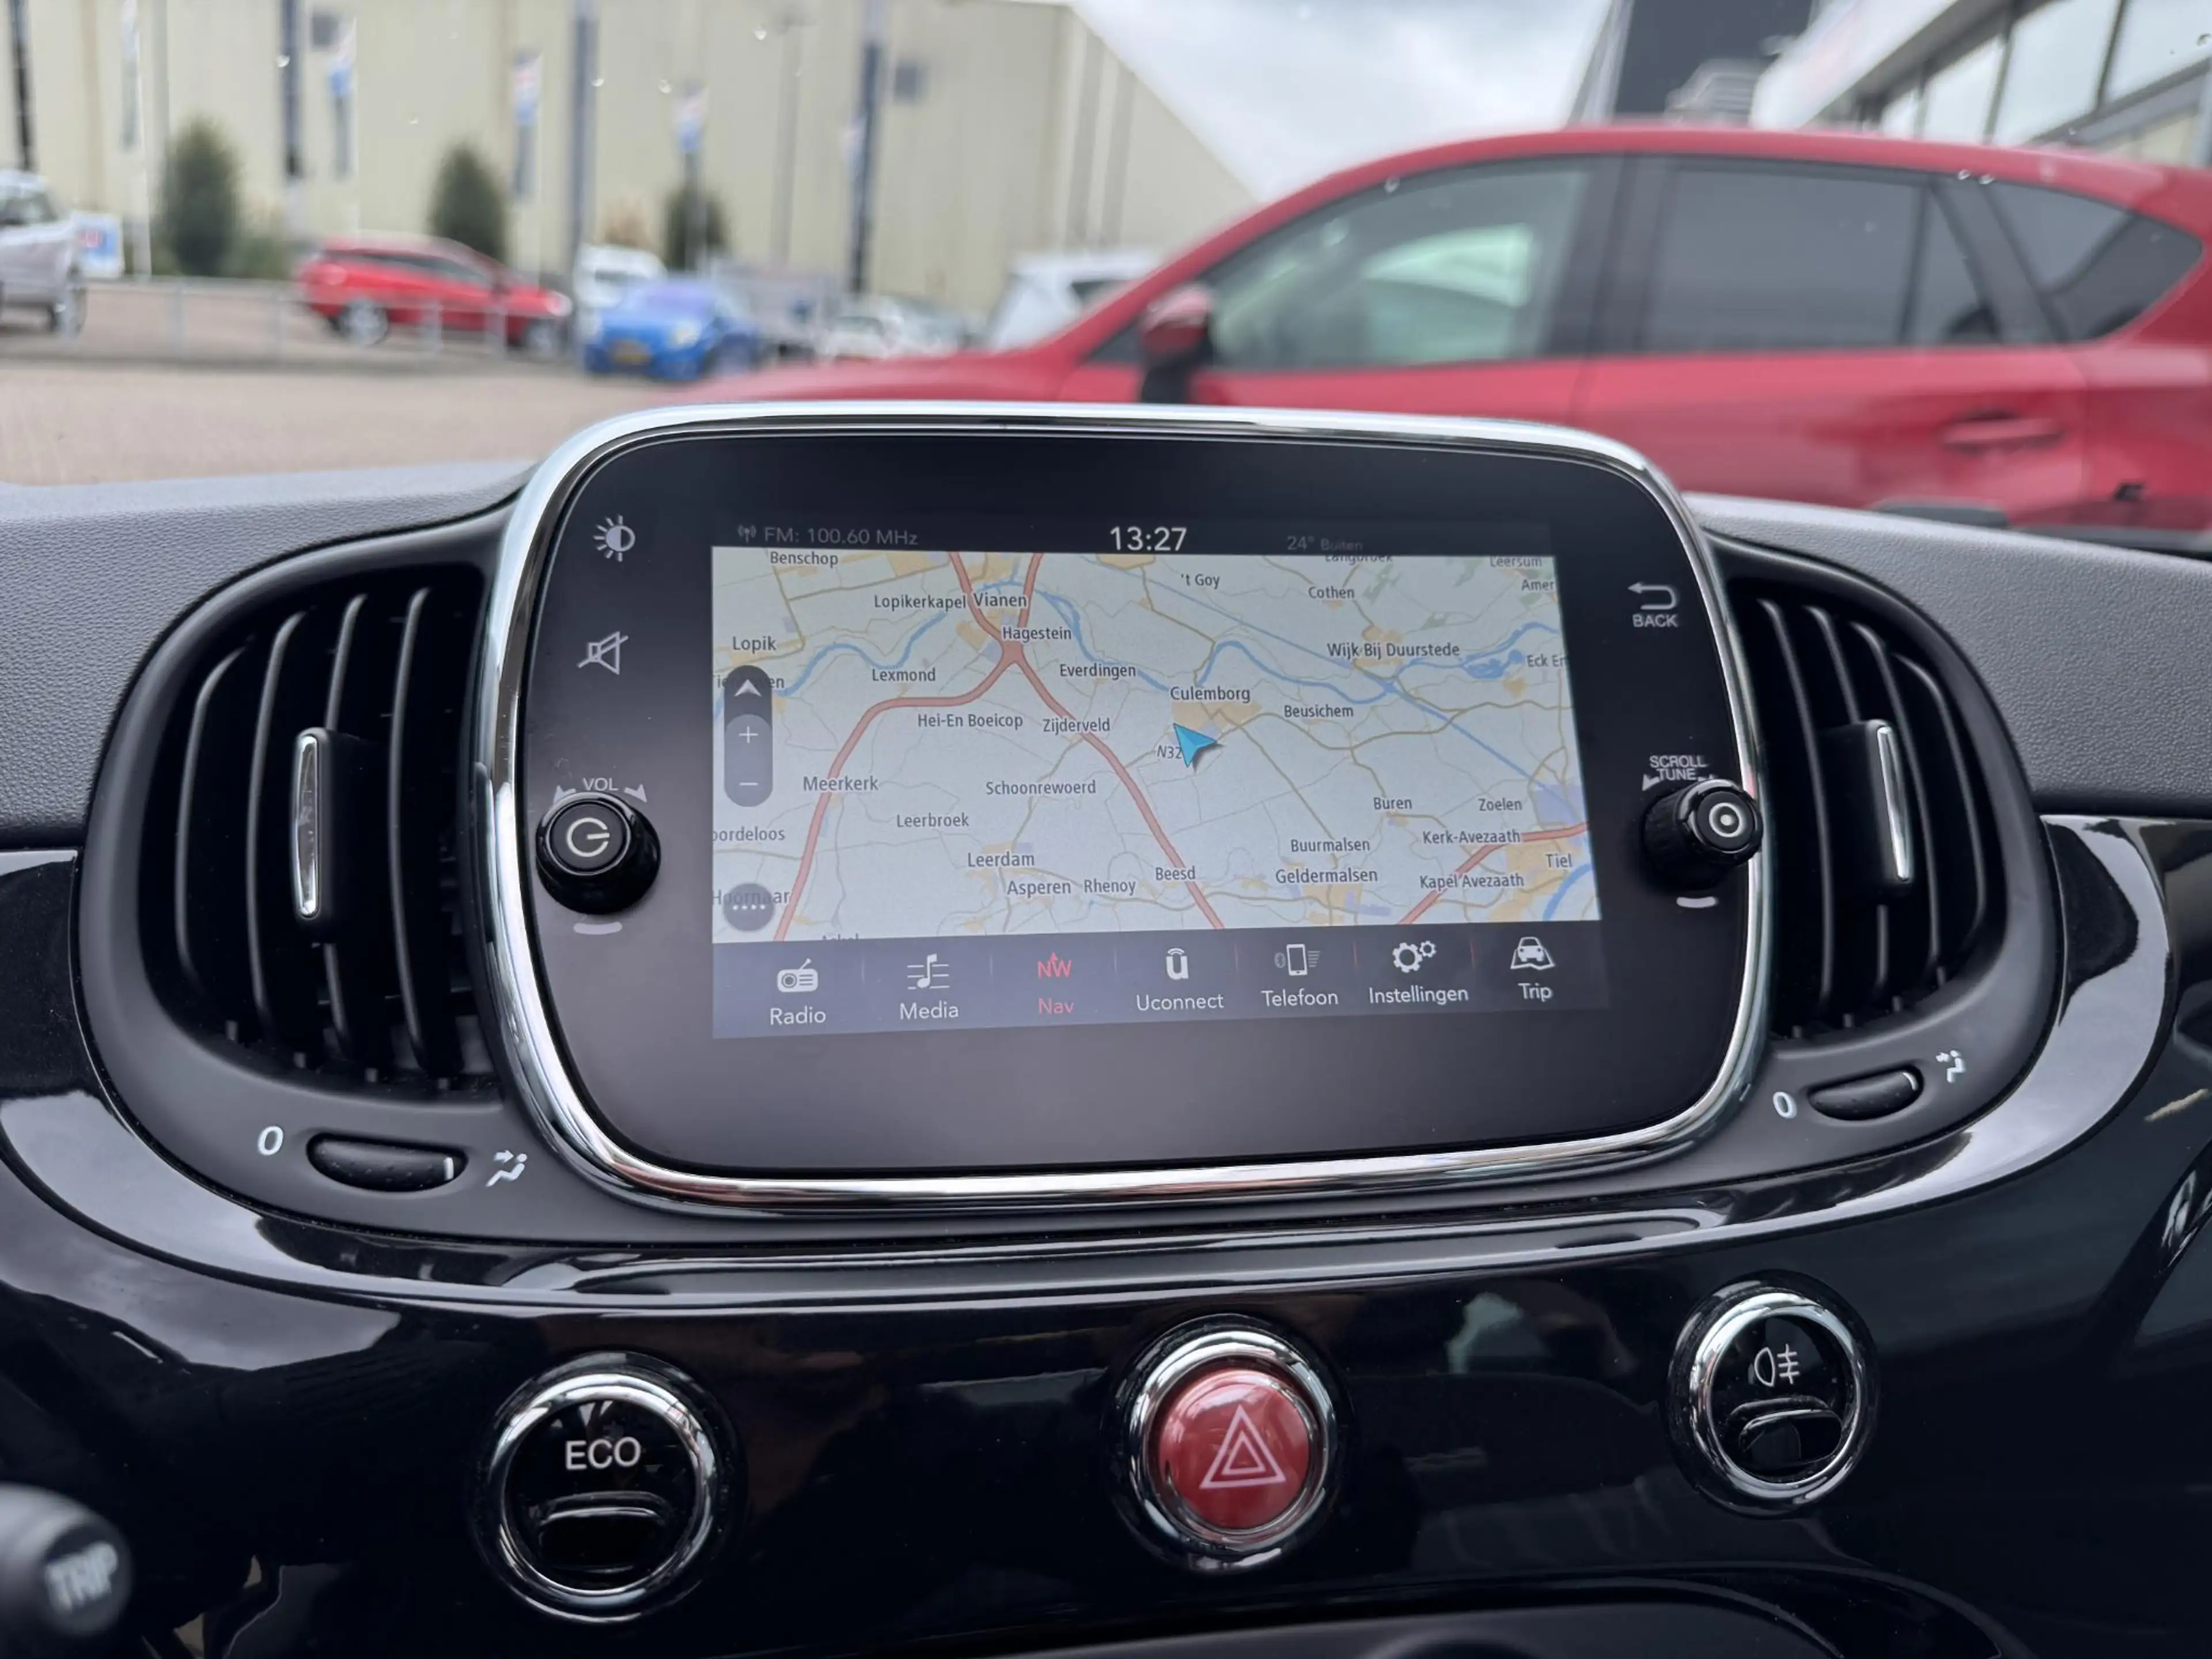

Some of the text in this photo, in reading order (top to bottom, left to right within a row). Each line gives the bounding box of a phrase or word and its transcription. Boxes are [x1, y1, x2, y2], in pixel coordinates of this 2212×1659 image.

[764, 528, 918, 546] FM: 100.60 MHz
[1111, 527, 1187, 551] 13:27
[770, 551, 839, 567] Benschop
[1195, 574, 1220, 589] Goy
[974, 593, 1028, 608] Vianen
[1308, 586, 1355, 600] Cothen
[874, 593, 967, 612] Lopikerkapel
[1633, 613, 1678, 627] BACK
[1002, 626, 1071, 643] Hagestein
[732, 636, 777, 653] Lopik
[1327, 642, 1460, 658] Wijk Bij Duurstede
[1527, 653, 1548, 668] Eck
[872, 667, 936, 683] Lexmond
[1060, 663, 1136, 680] Everdingen
[1170, 687, 1251, 703] Culemborg
[1284, 704, 1354, 719] Beusichem
[918, 713, 1023, 730] Hei-En Boeicop
[1043, 717, 1110, 736] Zijderveld
[1650, 755, 1707, 768] SCROLL
[1656, 768, 1697, 781] TUNE
[583, 778, 619, 791] VOL
[803, 777, 878, 791] Meerkerk
[986, 781, 1096, 796] Schoonrewoerd
[1373, 796, 1412, 810] Buren
[1479, 798, 1522, 812] Zoelen
[897, 813, 969, 828] Leerbroek
[1423, 829, 1521, 844] Kerk-Avezaath
[1290, 838, 1370, 853] Buurmalsen
[967, 853, 1035, 868] Leerdam
[1546, 853, 1572, 869] Tiel
[1155, 866, 1196, 881] Beesd
[1275, 868, 1378, 884] Geldermalsen
[1007, 881, 1071, 897] Asperen
[1084, 879, 1135, 896] Rhenoy
[1420, 873, 1524, 891] Kapel Avezaath
[1262, 988, 1339, 1007] Telefoon
[1369, 986, 1468, 1006] Instellingen
[1518, 981, 1554, 1002] Trip
[1038, 997, 1074, 1015] Nav
[1136, 993, 1224, 1012] Uconnect
[770, 1007, 827, 1025] Radio
[900, 1002, 959, 1021] Media
[565, 1437, 641, 1470] ECO
